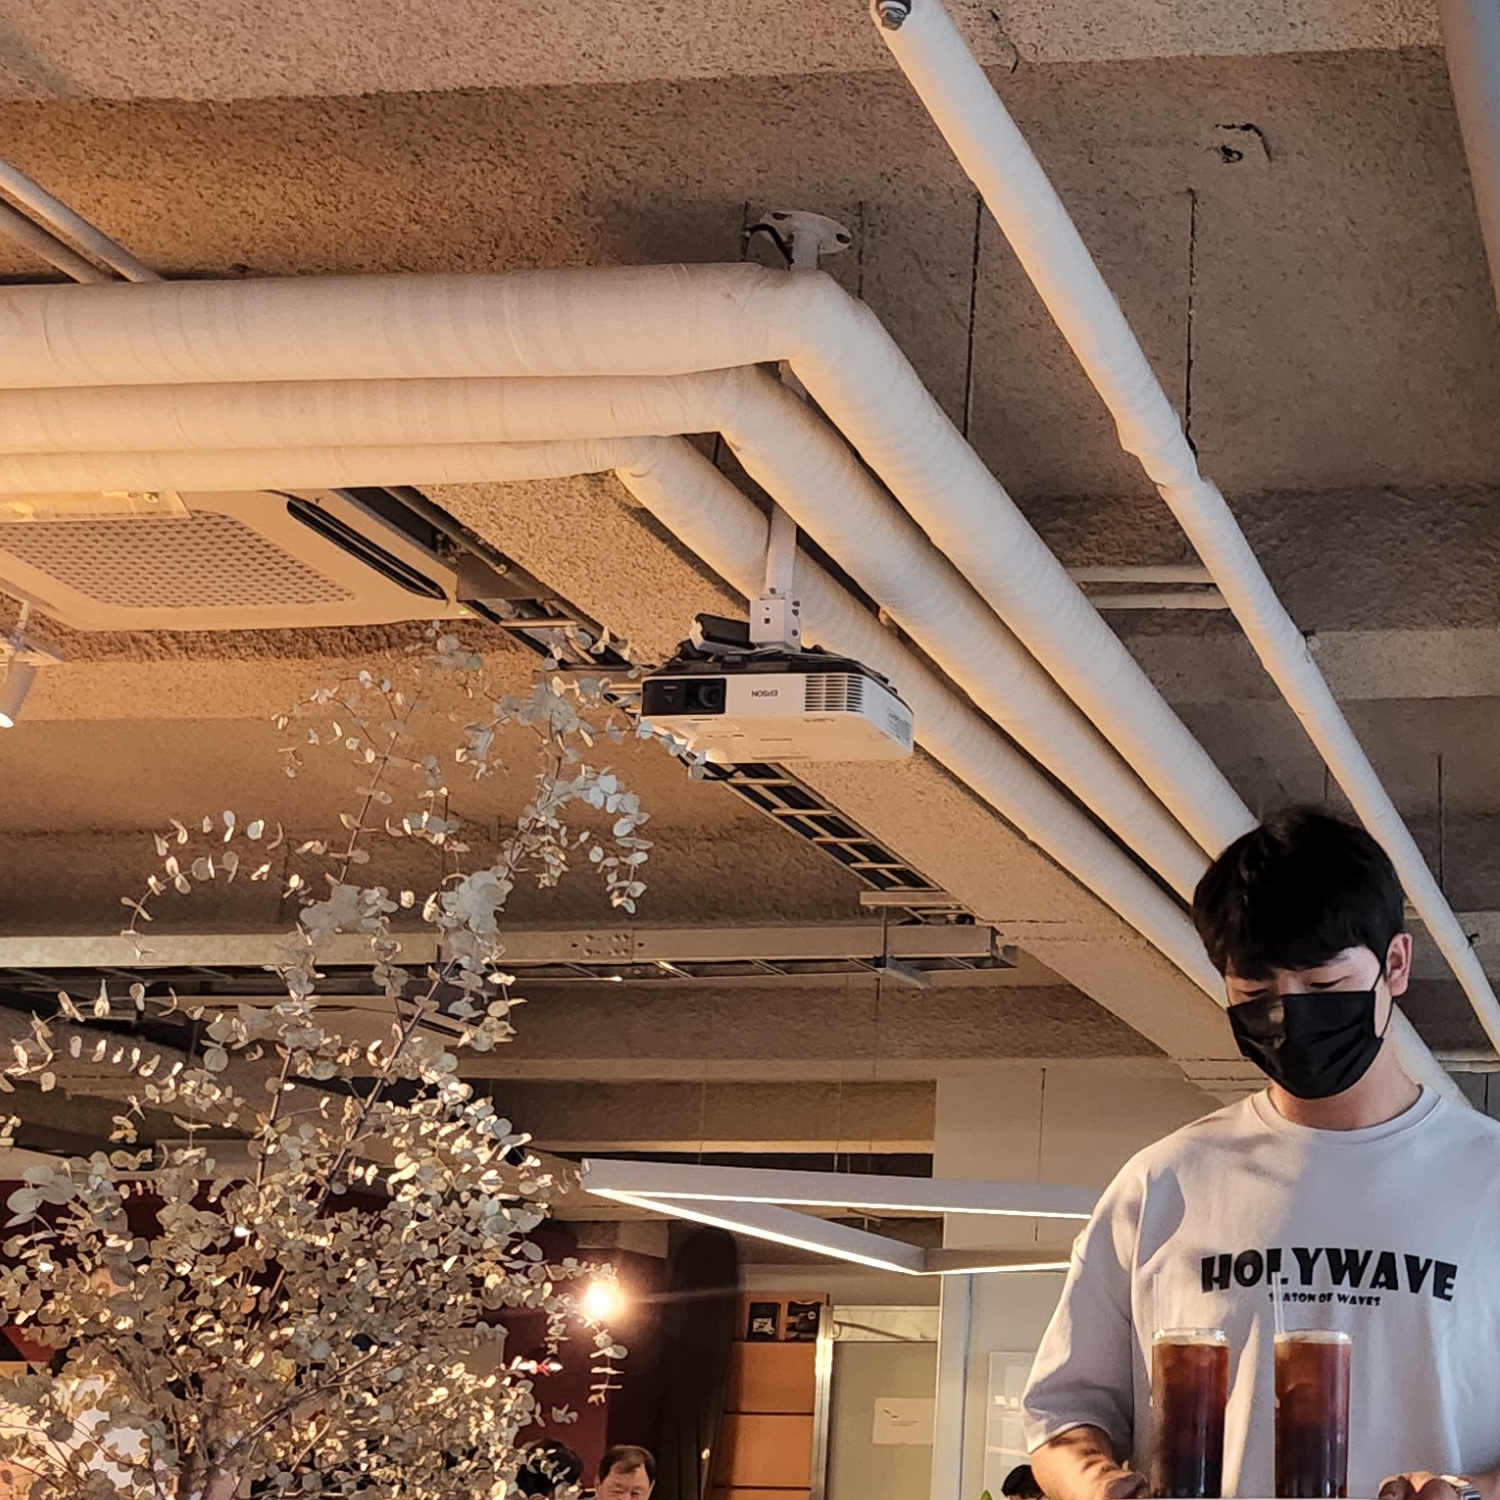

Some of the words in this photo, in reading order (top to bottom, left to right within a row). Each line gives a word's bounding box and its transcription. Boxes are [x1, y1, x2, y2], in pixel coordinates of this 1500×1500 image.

[751, 689, 779, 698] EPSON
[1201, 1247, 1458, 1302] HOLYWAVE
[1268, 1292, 1316, 1303] SASON
[1318, 1292, 1334, 1303] OF
[1337, 1293, 1381, 1306] WAVES
